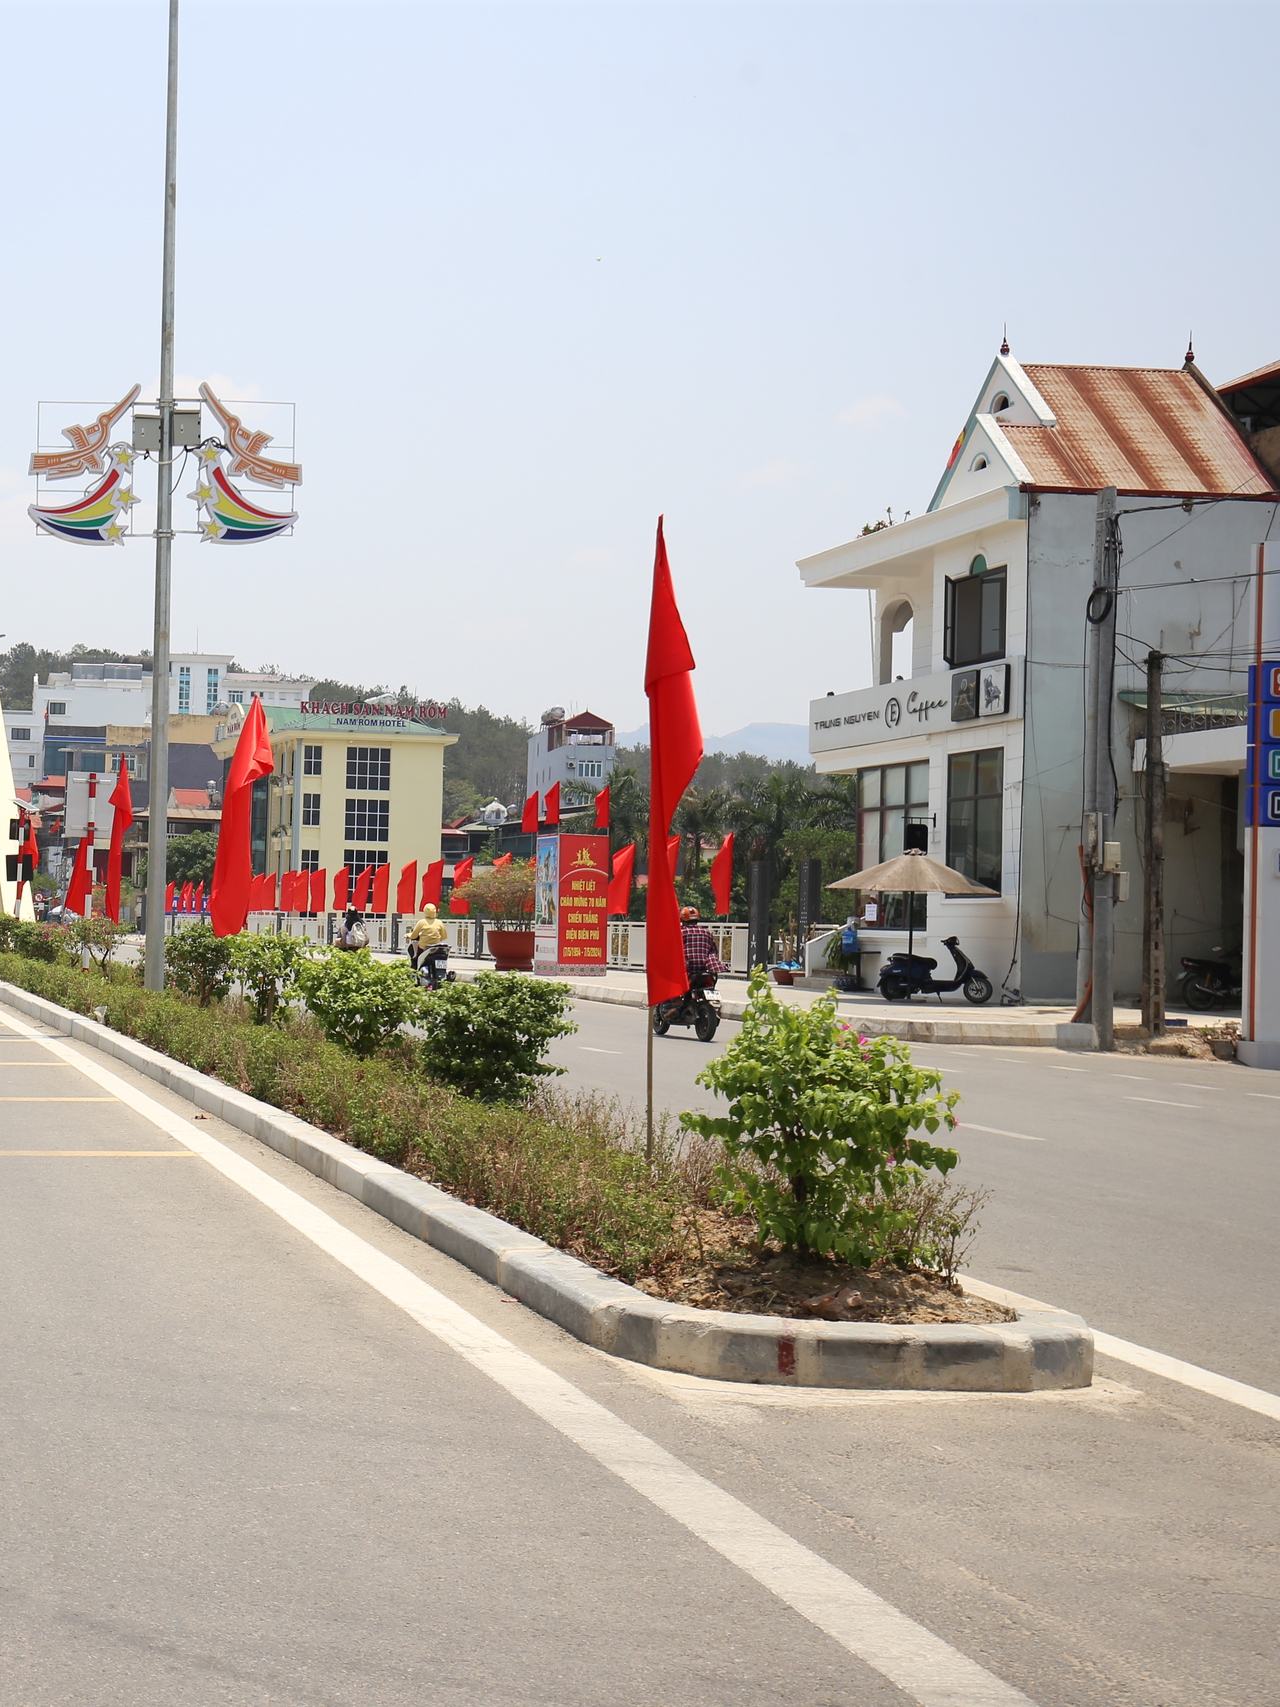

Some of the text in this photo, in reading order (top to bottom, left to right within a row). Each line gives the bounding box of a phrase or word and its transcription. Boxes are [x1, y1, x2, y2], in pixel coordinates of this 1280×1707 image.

[300, 698, 349, 715] KHÁCH
[353, 703, 380, 719] SẠN
[814, 717, 841, 731] TRUNG
[843, 710, 880, 726] NGUYEN
[906, 691, 948, 722] Coffee
[379, 719, 407, 728] HOTEL
[588, 897, 595, 907] 70
